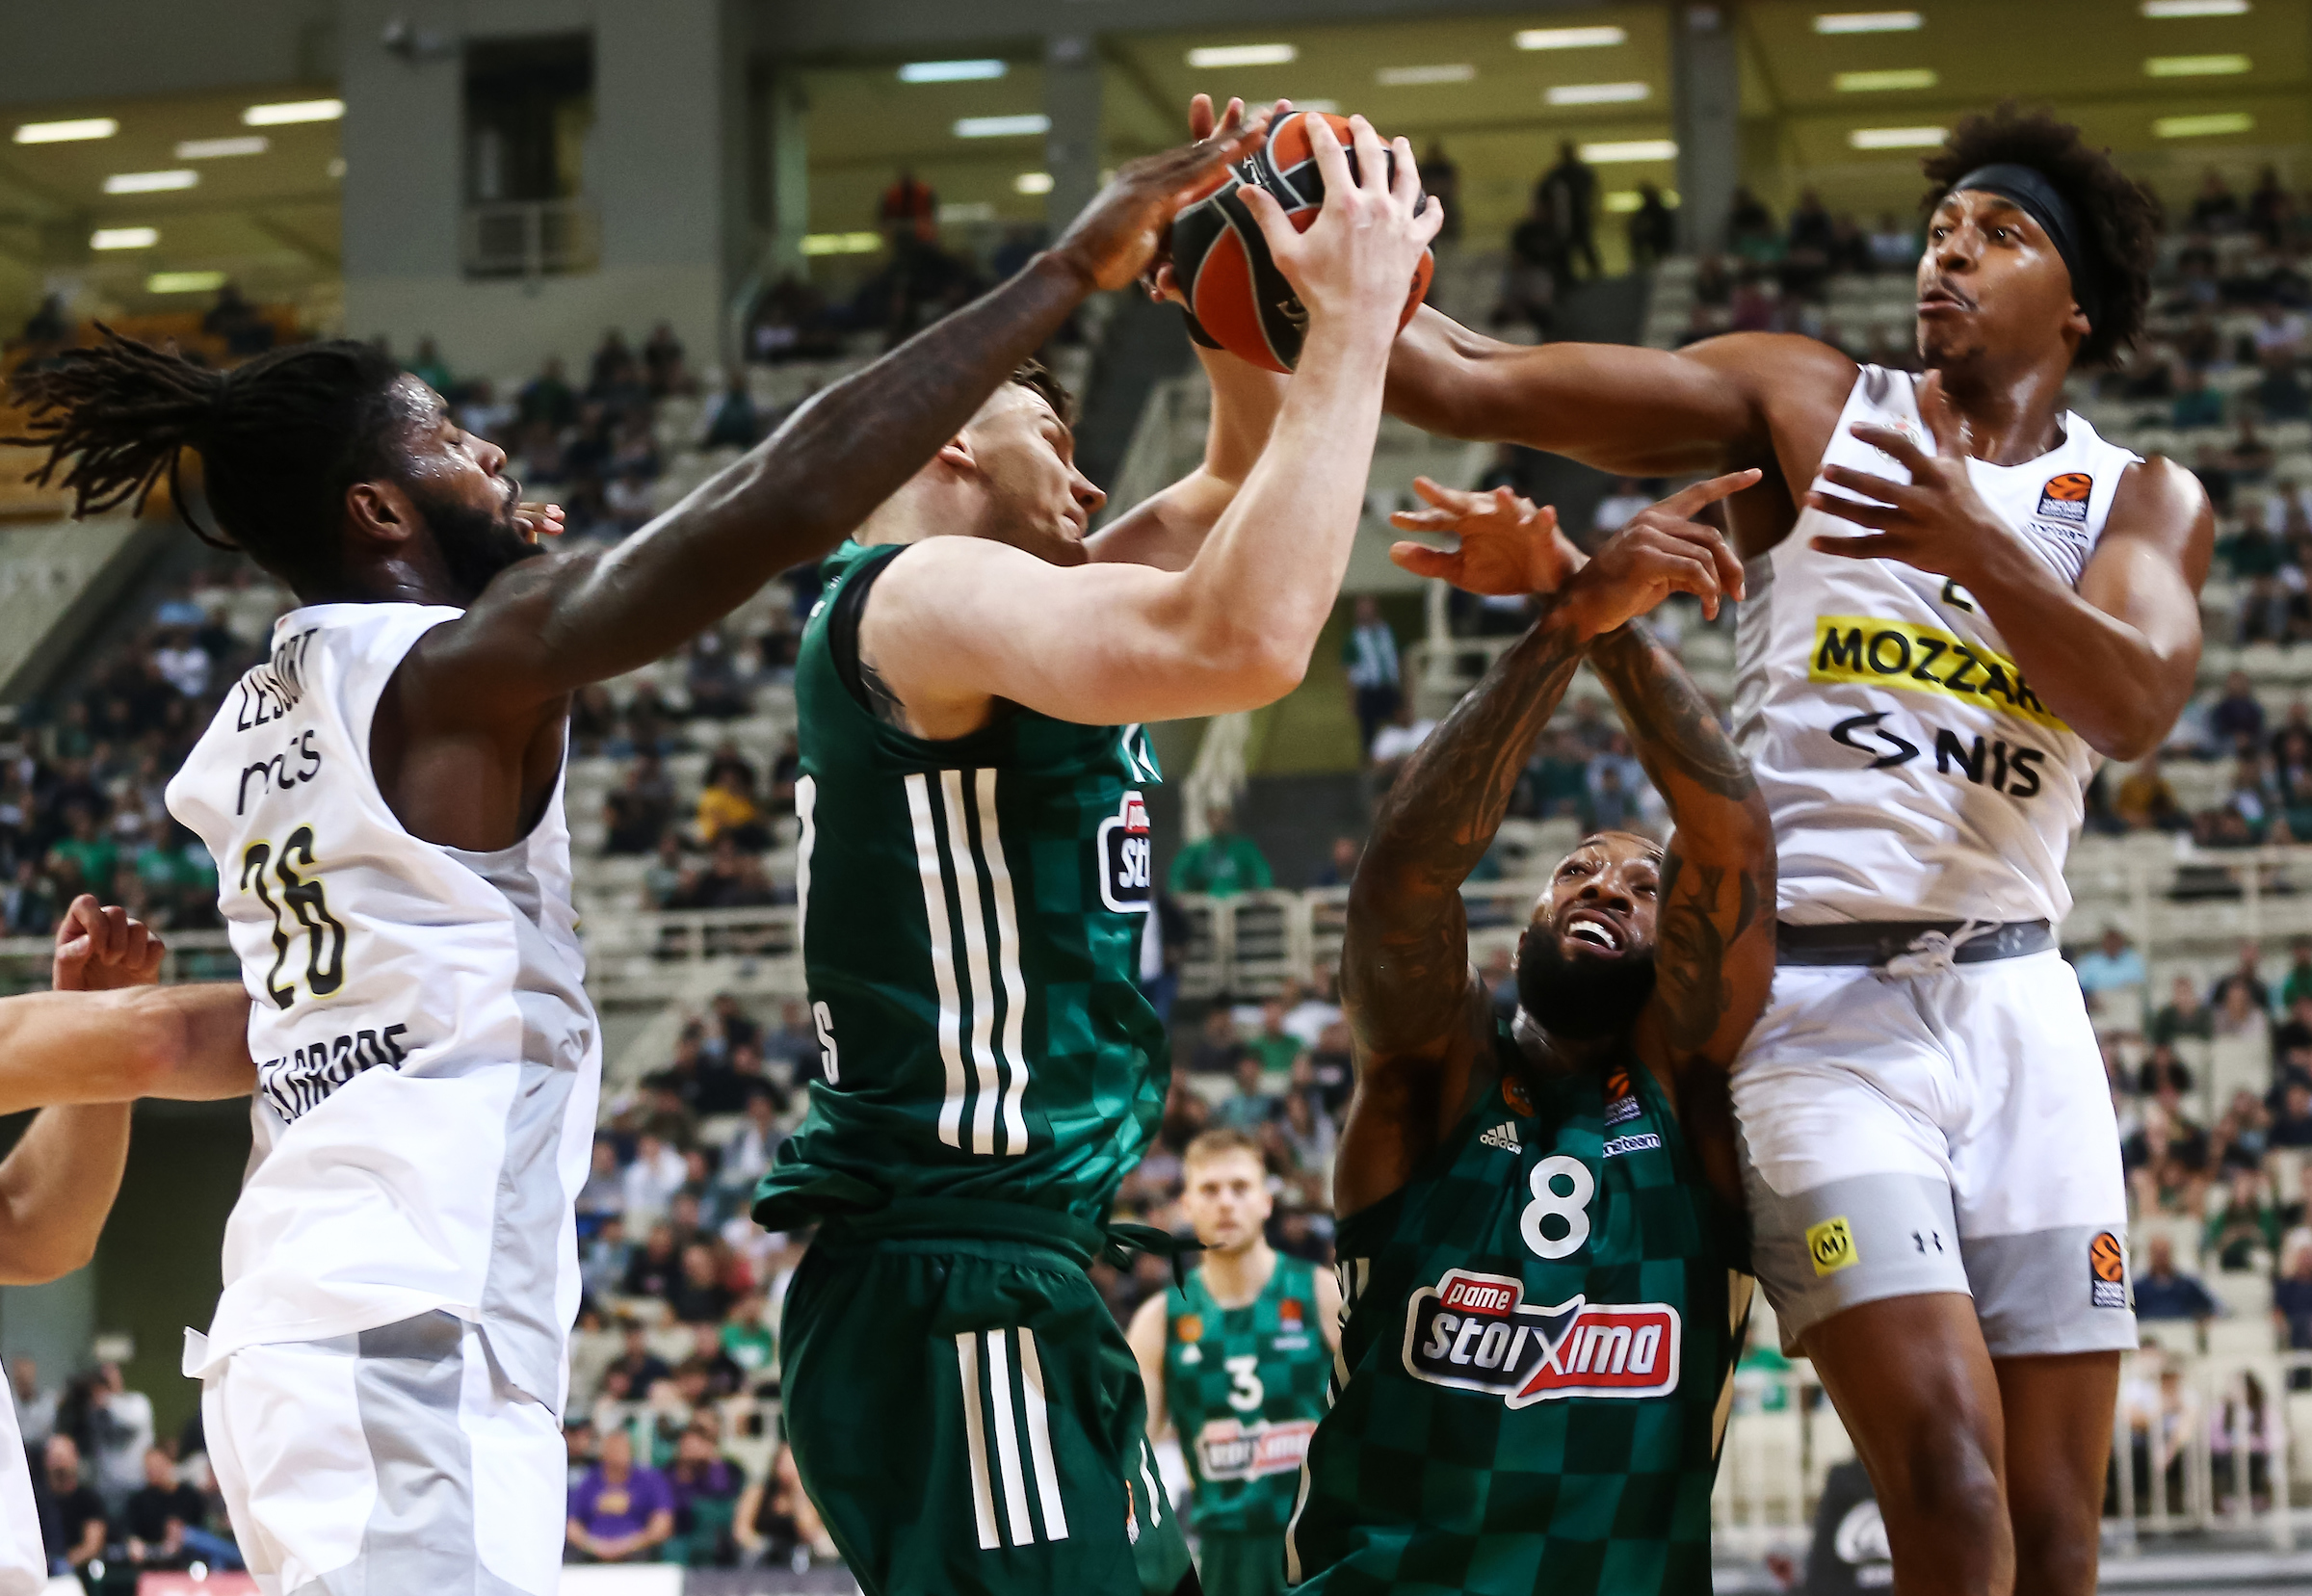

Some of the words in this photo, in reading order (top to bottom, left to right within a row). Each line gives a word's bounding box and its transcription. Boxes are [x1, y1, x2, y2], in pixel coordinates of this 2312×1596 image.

[1818, 627, 2047, 713] MOZZAR
[1935, 727, 2045, 798] NIS
[241, 824, 346, 1010] 26
[1480, 1133, 1523, 1155] adidas
[1520, 1155, 1595, 1260] 8
[1446, 1282, 1511, 1311] pame
[1224, 1354, 1265, 1412] 3
